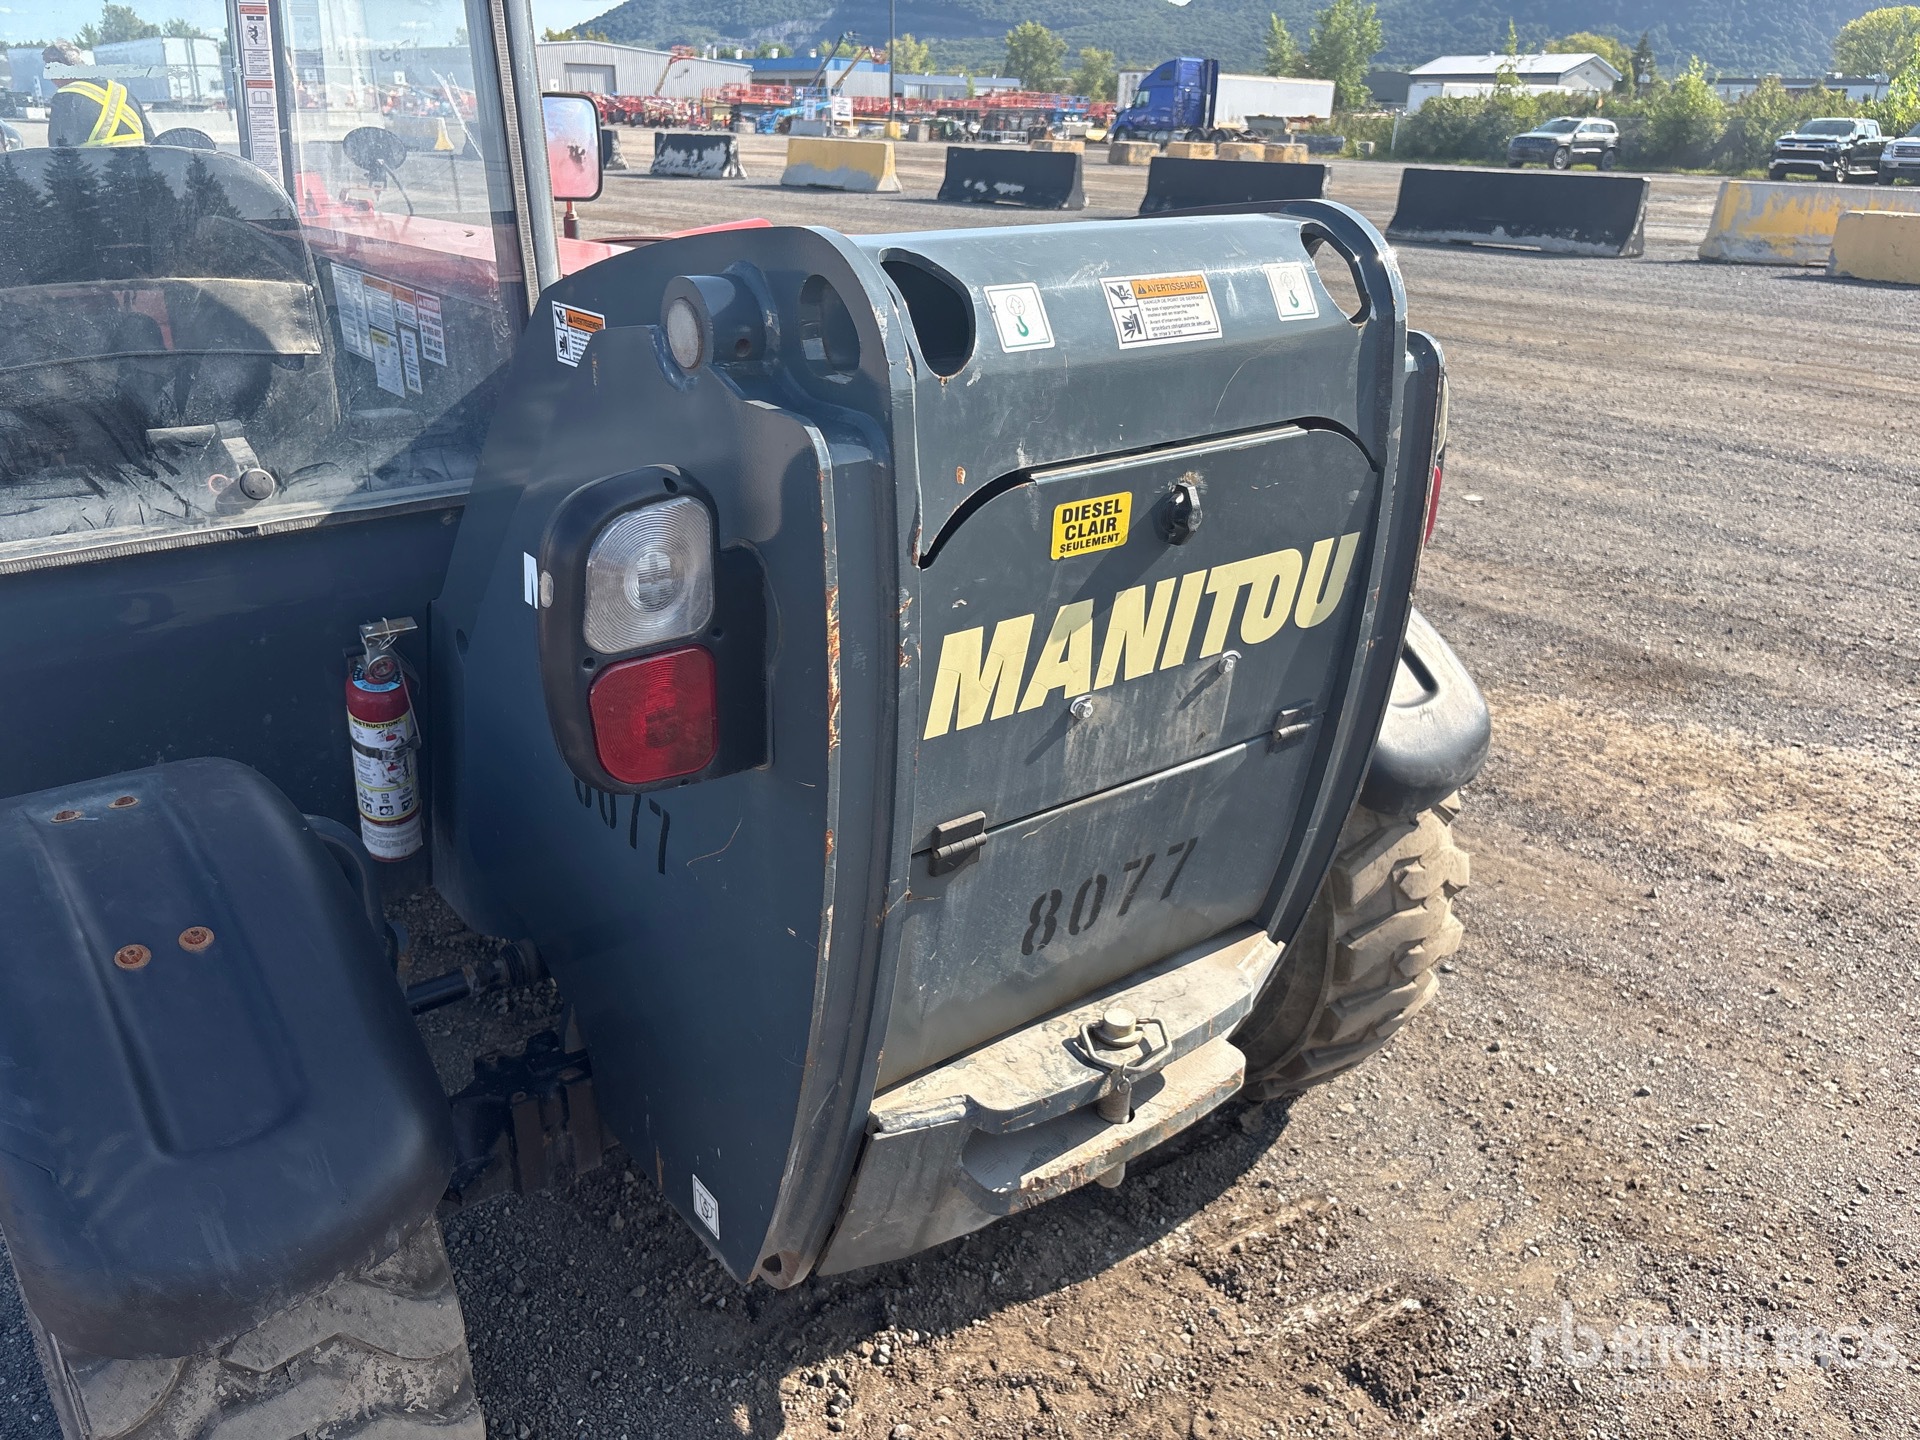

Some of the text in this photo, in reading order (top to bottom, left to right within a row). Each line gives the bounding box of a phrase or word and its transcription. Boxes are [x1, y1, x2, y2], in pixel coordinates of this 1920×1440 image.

[1147, 281, 1203, 293] AVERTISSEMENT
[1062, 499, 1122, 524] DIESEL
[1065, 517, 1117, 541] CLAIR
[1060, 533, 1120, 553] SEULEMENT
[923, 532, 1360, 740] MANITOU
[1021, 837, 1198, 955] 8077
